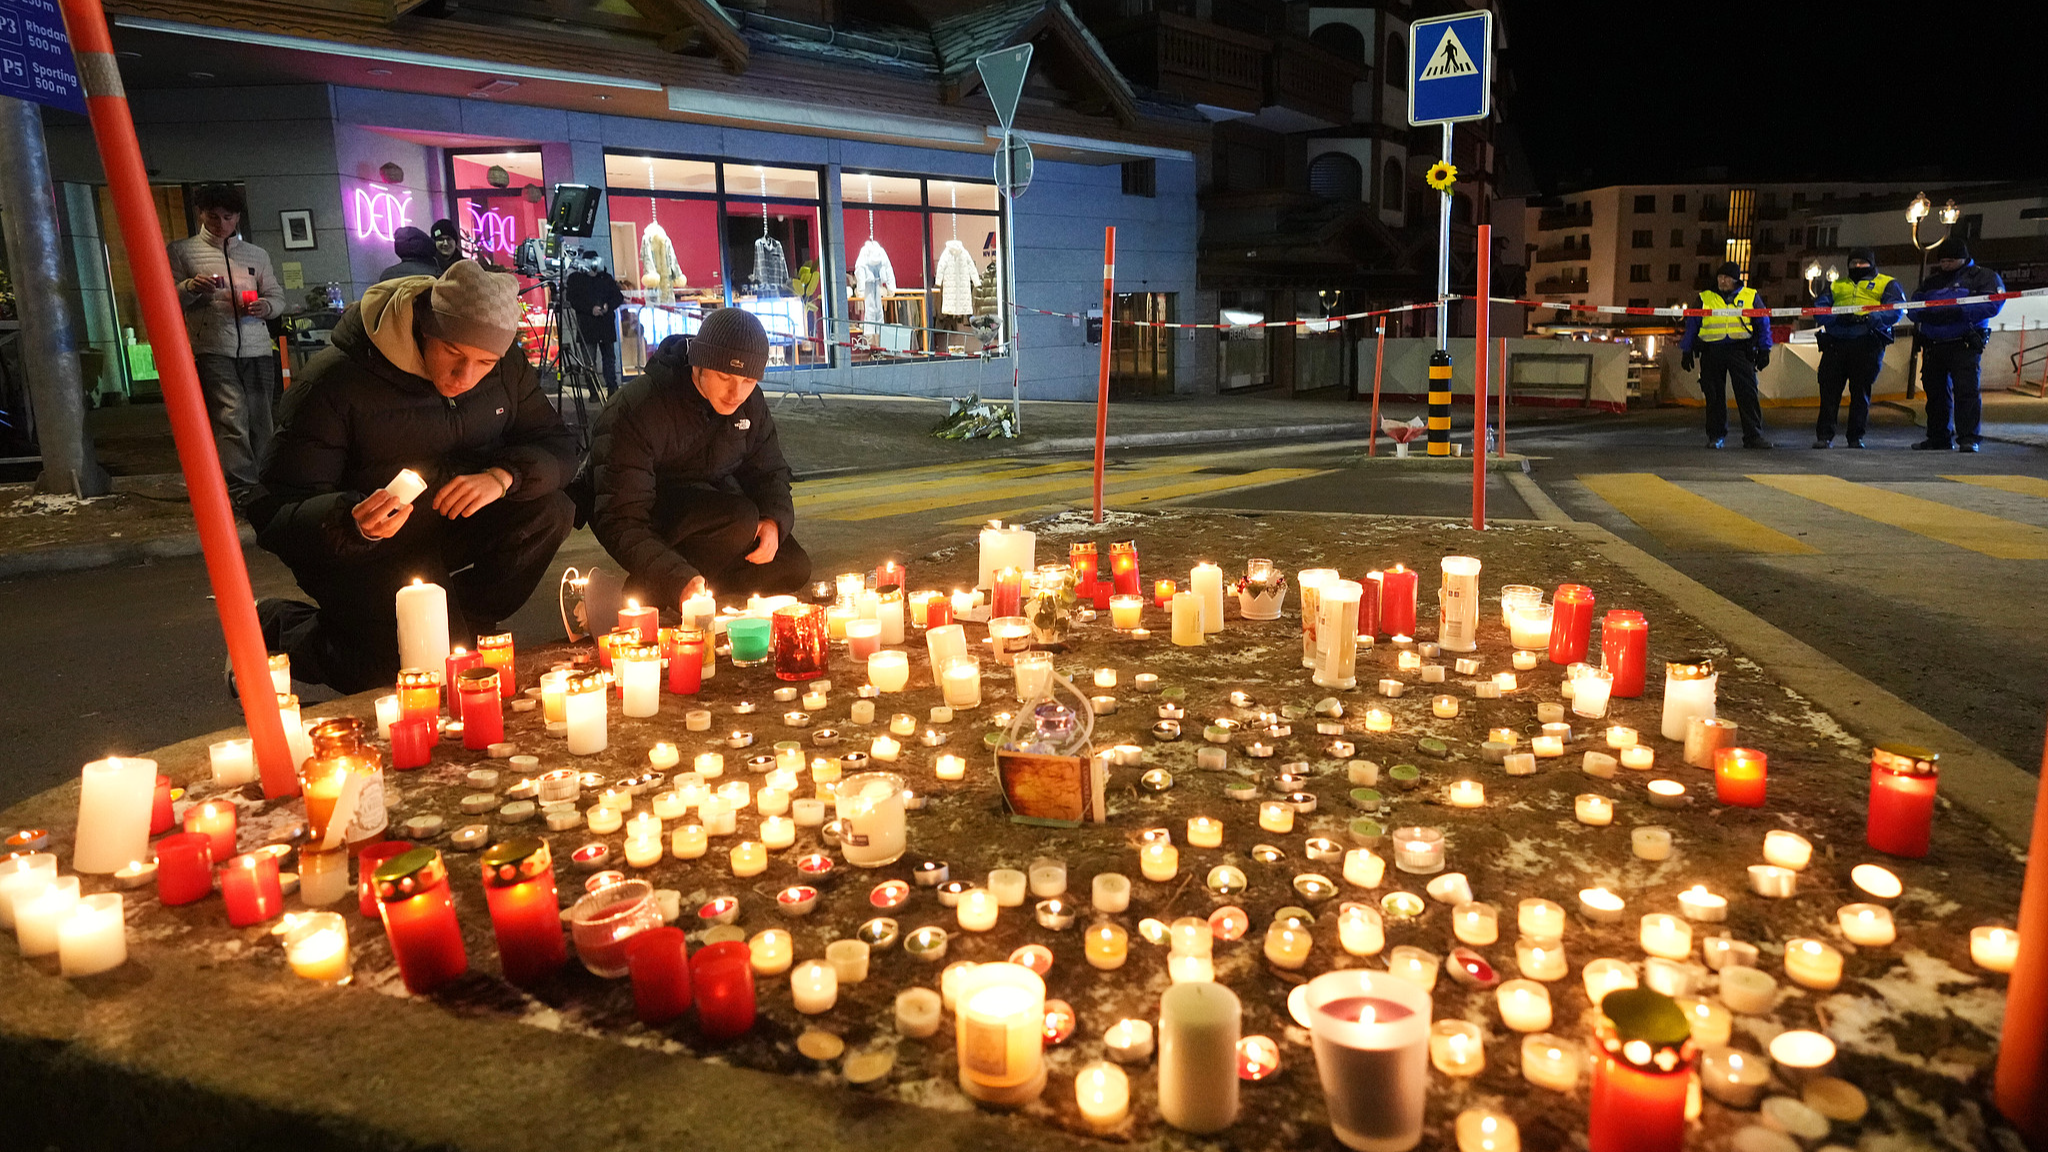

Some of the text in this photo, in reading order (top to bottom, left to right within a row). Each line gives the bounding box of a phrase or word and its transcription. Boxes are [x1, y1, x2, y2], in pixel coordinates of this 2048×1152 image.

[43, 1, 54, 12] m
[0, 16, 17, 34] P3
[28, 35, 61, 55] 500 m
[3, 58, 23, 77] P5
[32, 61, 77, 87] Sporting
[35, 76, 67, 96] 500 m
